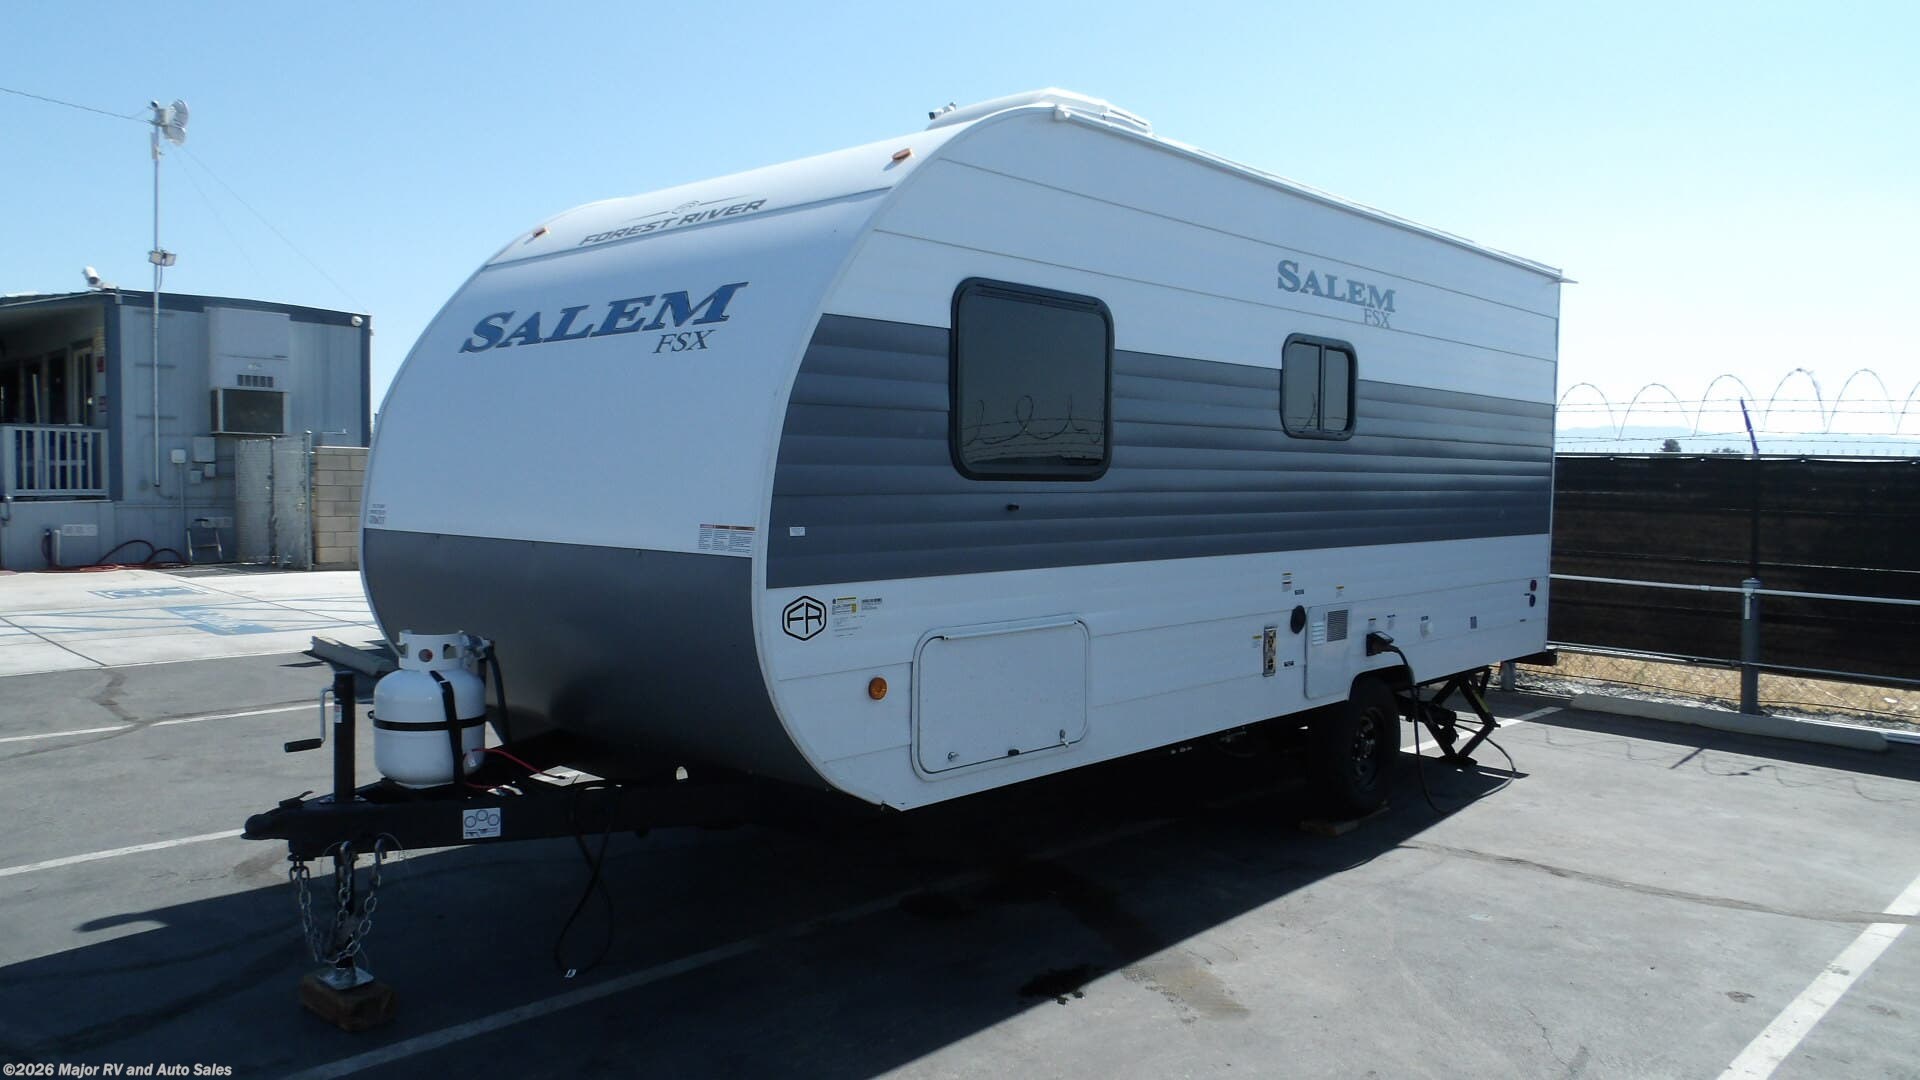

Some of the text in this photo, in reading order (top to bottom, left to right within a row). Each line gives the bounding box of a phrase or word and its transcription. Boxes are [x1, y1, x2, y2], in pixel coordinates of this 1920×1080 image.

[579, 199, 767, 246] FOREST RIVER
[1277, 260, 1395, 312] SALEM
[458, 281, 749, 353] SALEM
[1364, 308, 1391, 328] FSX
[652, 329, 715, 354] FSX
